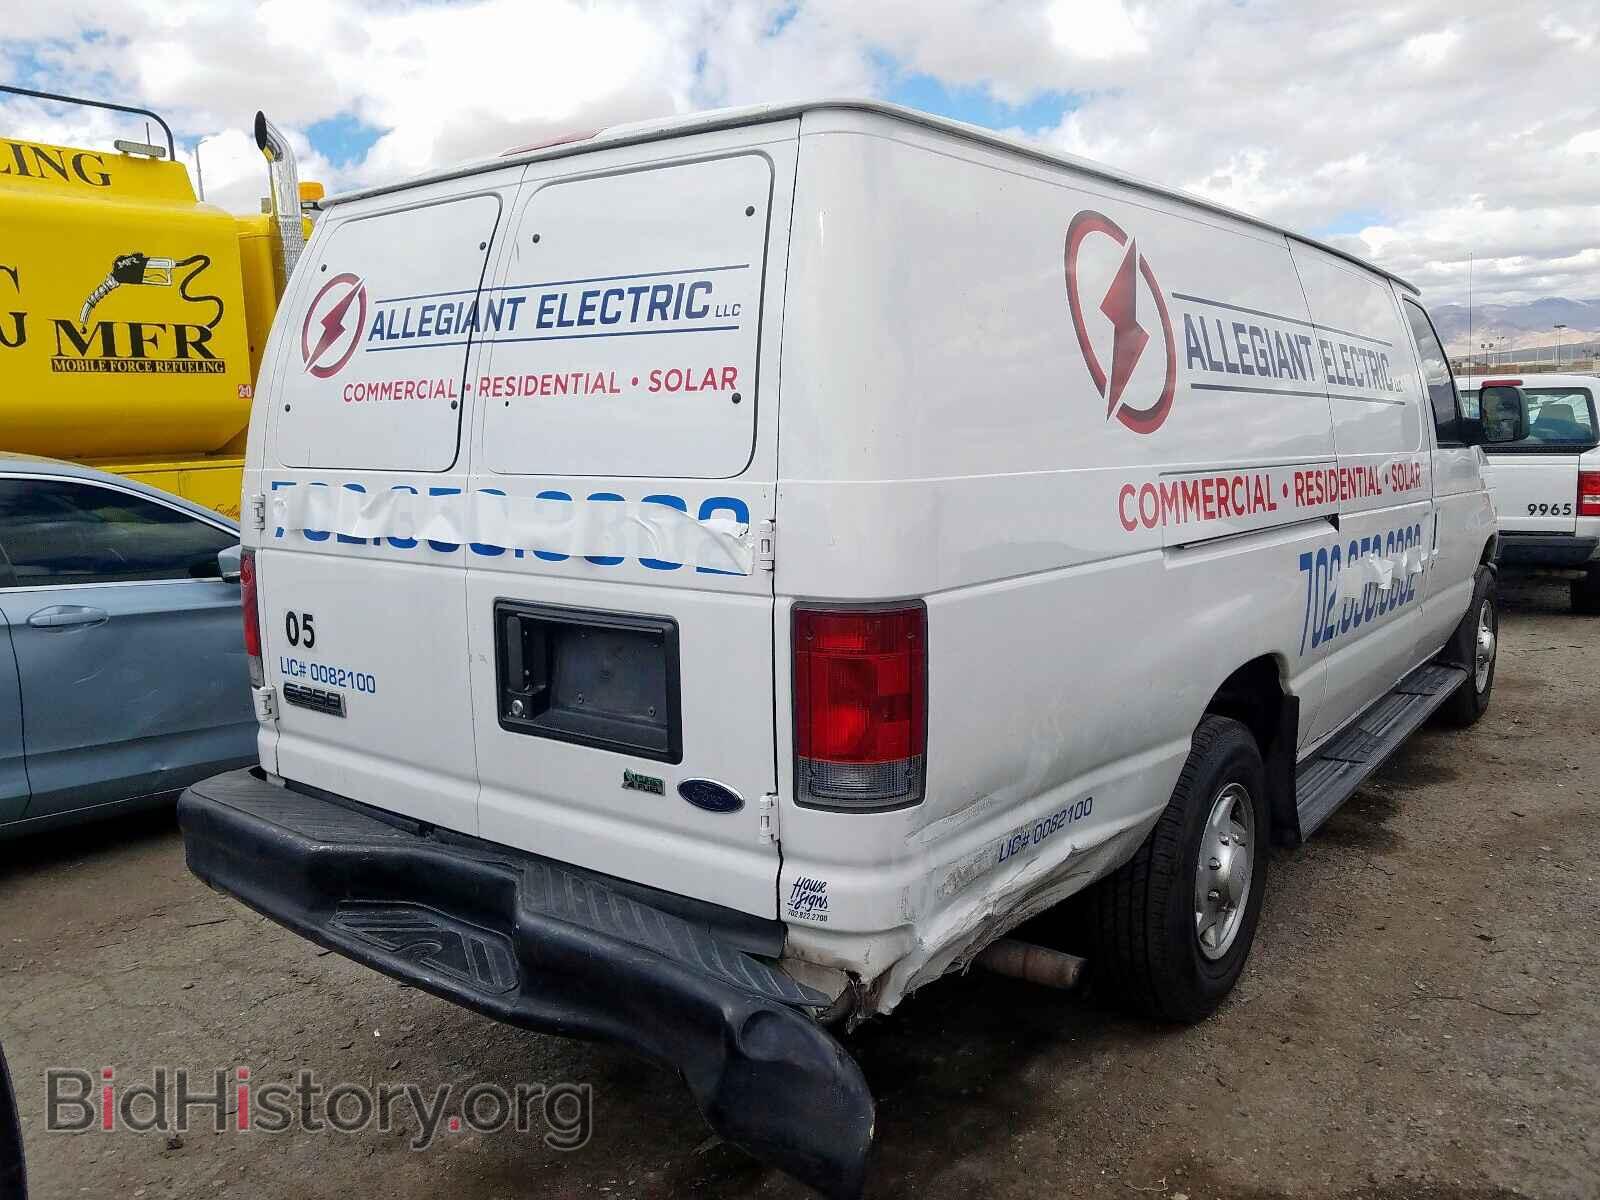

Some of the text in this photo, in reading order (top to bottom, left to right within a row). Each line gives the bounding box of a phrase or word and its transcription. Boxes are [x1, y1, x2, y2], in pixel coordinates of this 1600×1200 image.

[367, 280, 742, 342] ALLEGIANT ELECTRIC LLC
[48, 318, 219, 360] MFR
[1183, 313, 1316, 382] ALLEGIANT
[1317, 339, 1394, 392] ELECTRIC
[54, 358, 225, 374] MOBILE FORCE REFUELING
[343, 366, 738, 403] COMMERCIAL RESIDENTIAL SOLAR
[1118, 462, 1423, 532] COMMERCIAL RESIDENTIAL SOLAR
[1527, 503, 1572, 516] 9965
[286, 610, 315, 648] 05
[280, 656, 376, 694] LIC# 0082100
[998, 796, 1094, 863] LIC# 0082100
[790, 876, 827, 899] House
